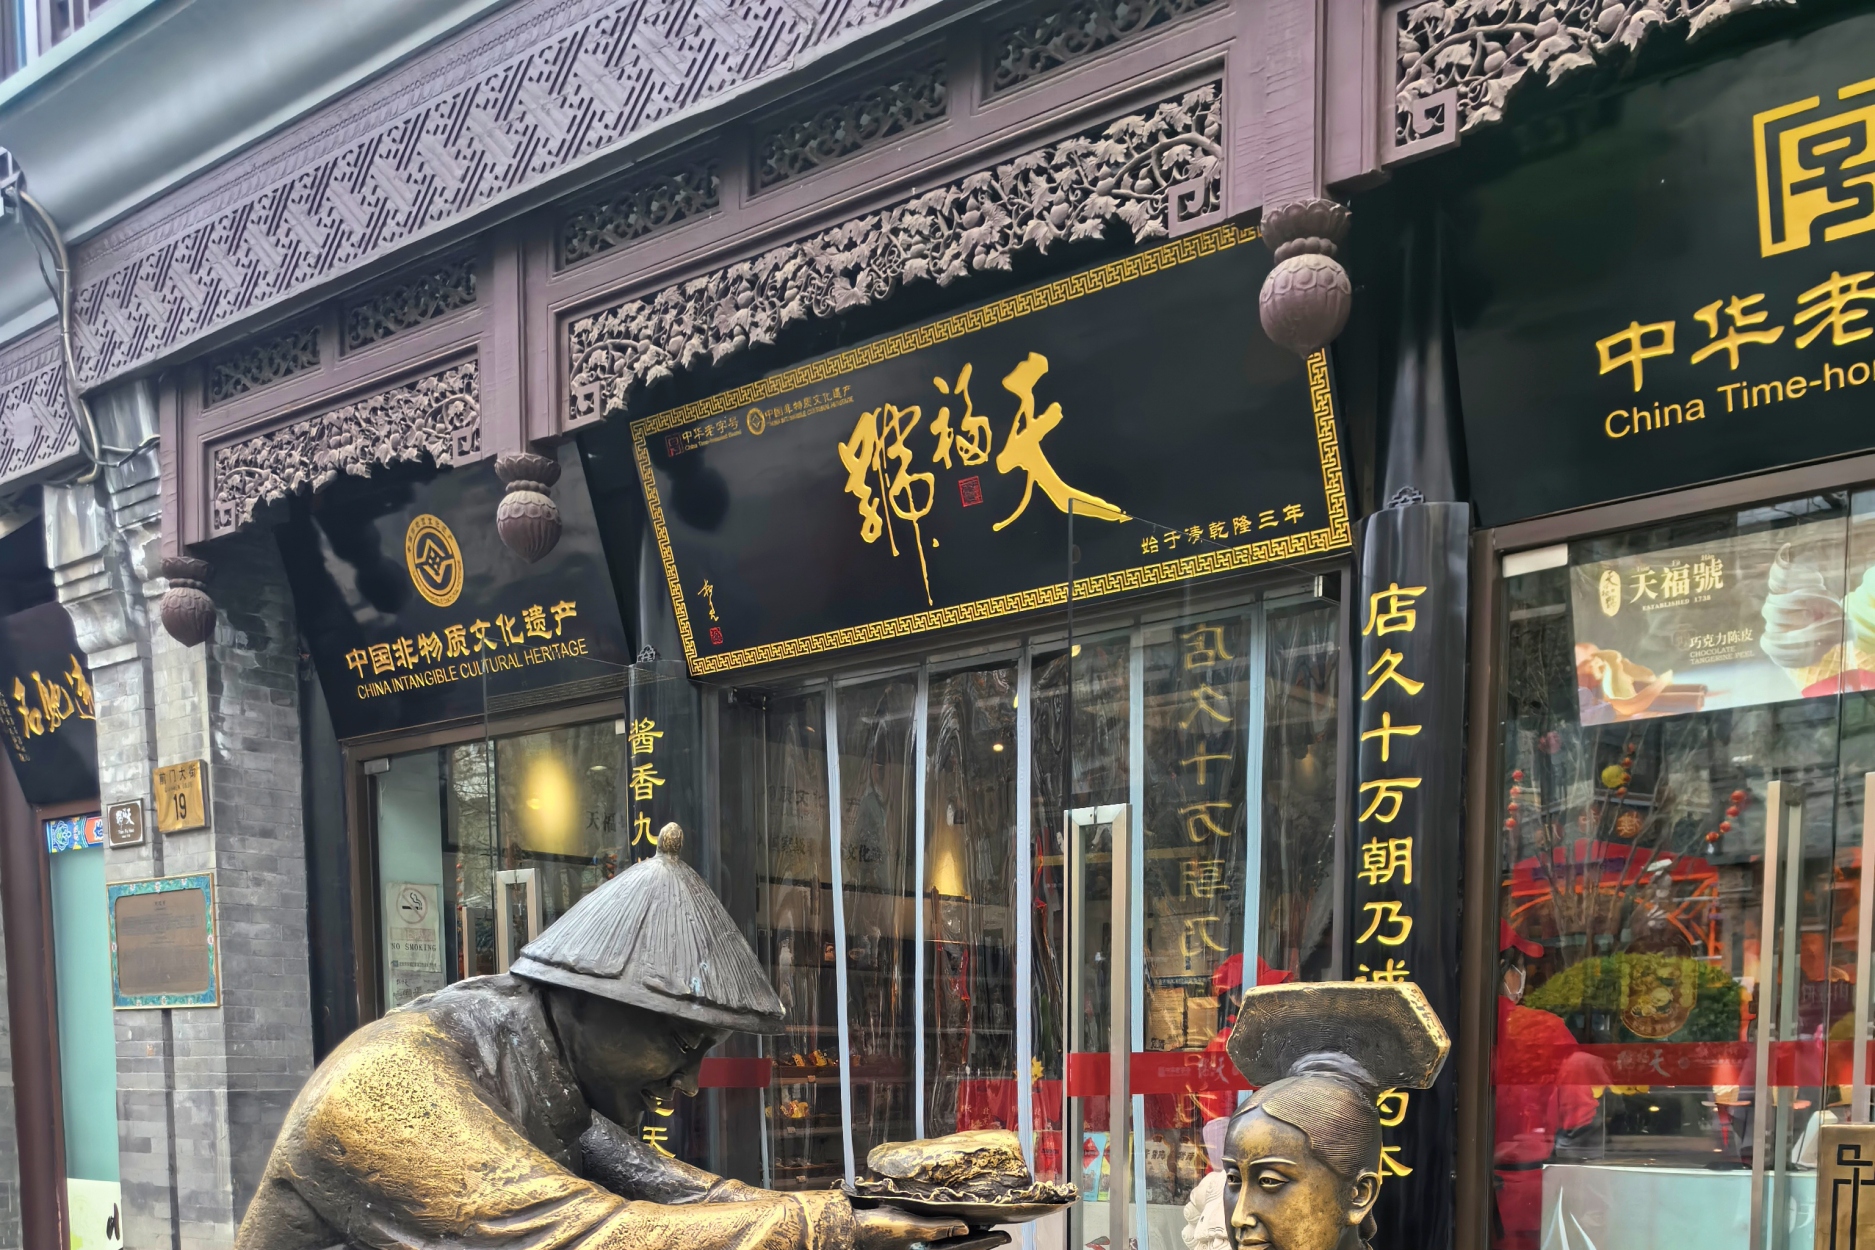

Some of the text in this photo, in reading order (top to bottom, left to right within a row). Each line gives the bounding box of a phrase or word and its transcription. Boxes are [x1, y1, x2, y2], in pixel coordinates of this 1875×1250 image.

[1605, 359, 1875, 438] China Time-ho
[1141, 503, 1304, 555] 始于清乾隆三年
[1629, 558, 1724, 604] 天福號
[1642, 598, 1690, 611] ESTABLISHED
[345, 600, 578, 679] 中国非物质文化遗产
[1689, 627, 1753, 649] 巧克力陈皮
[1689, 646, 1736, 658] CHOCOLATE
[1690, 653, 1733, 665] TANGERINE
[357, 638, 588, 700] CHINA INTANGIBLE CULTURAL HERITAGE
[158, 764, 197, 785] 前门大街
[173, 793, 187, 820] 19
[391, 942, 436, 952] NO SMOKING
